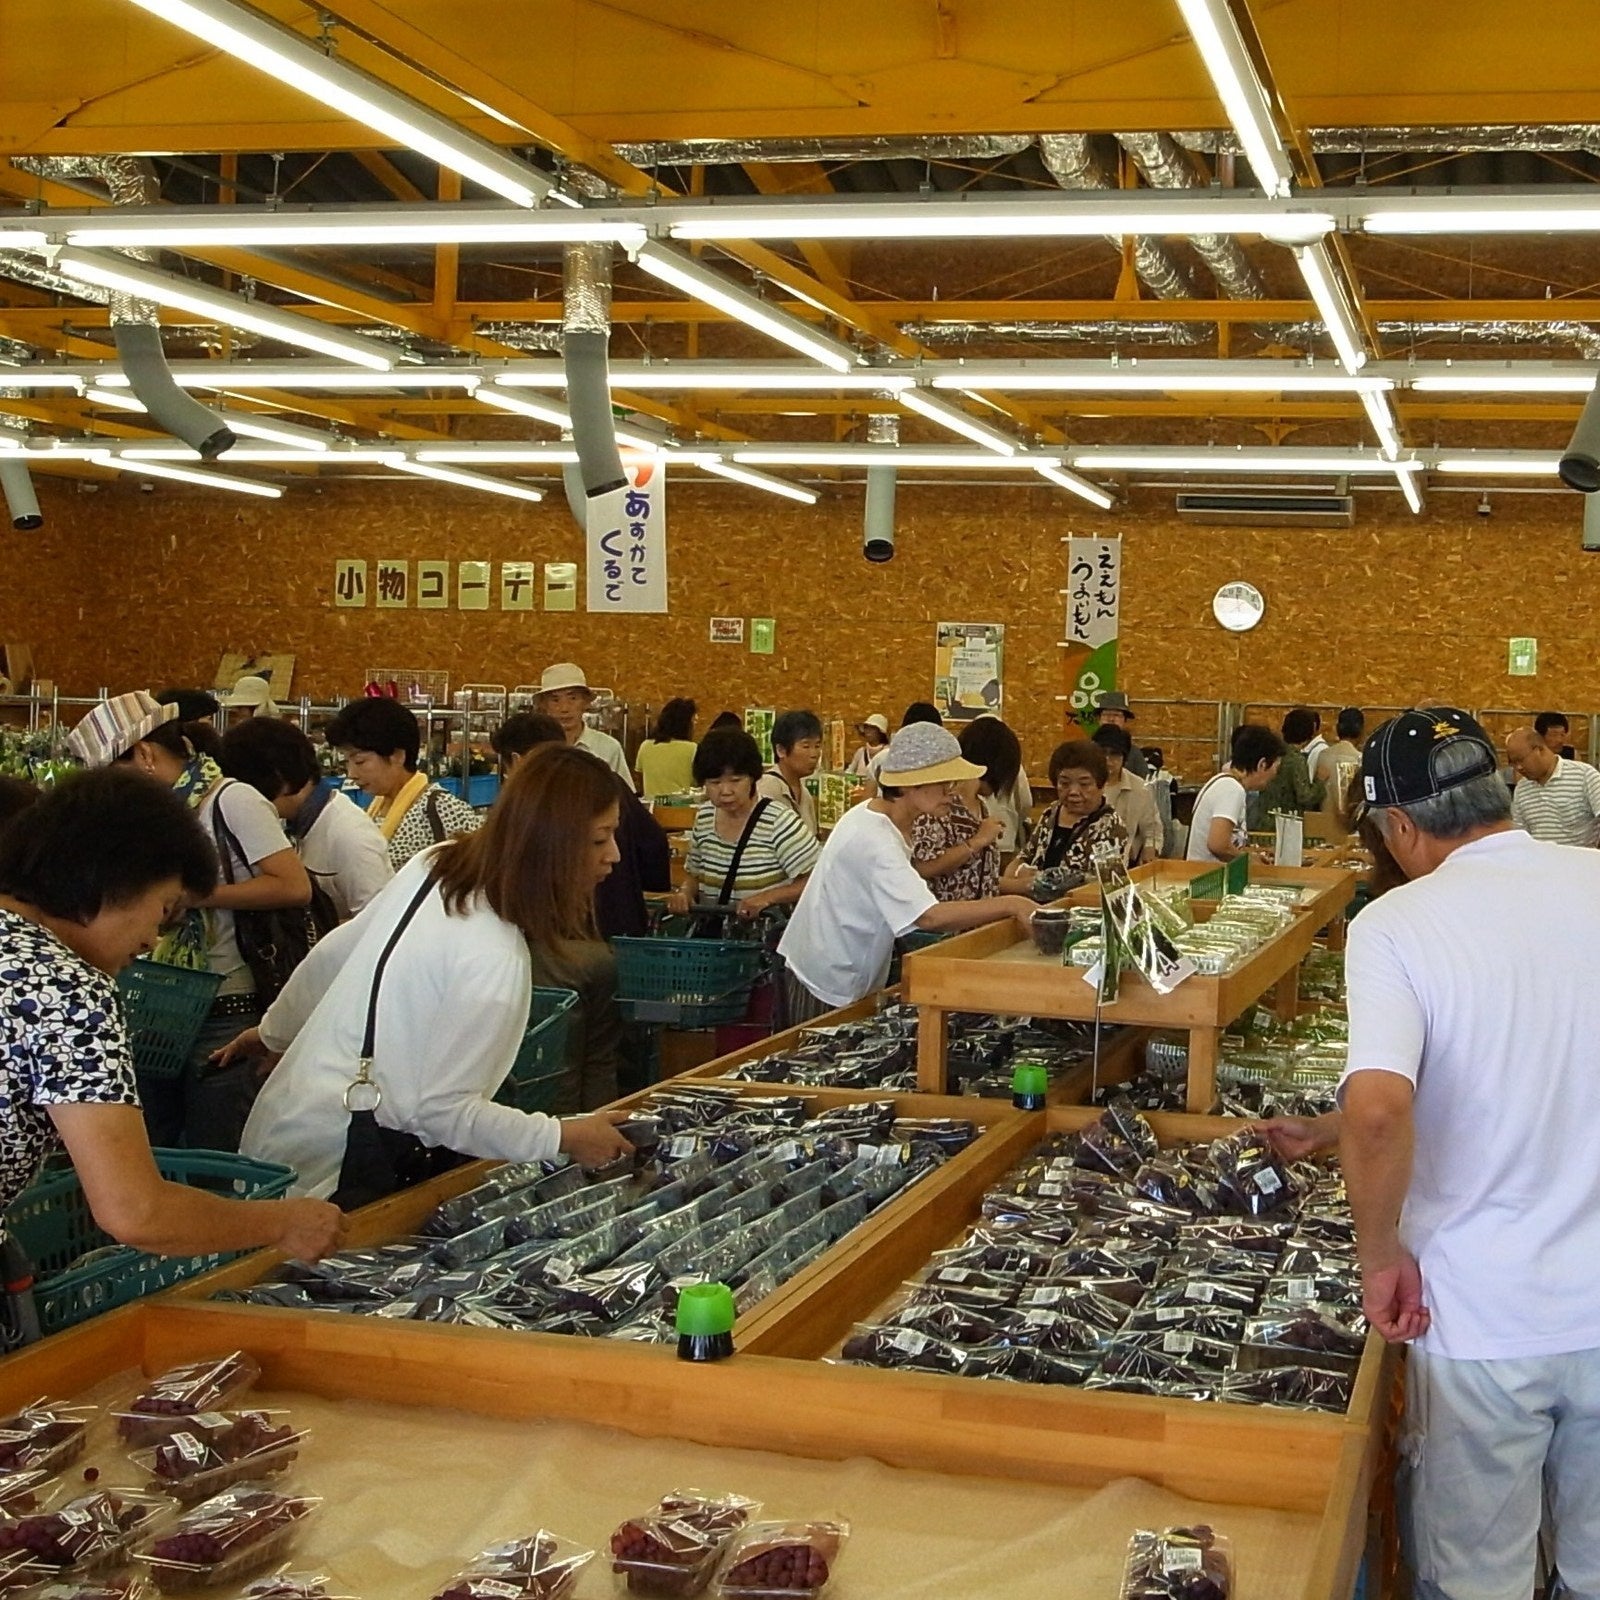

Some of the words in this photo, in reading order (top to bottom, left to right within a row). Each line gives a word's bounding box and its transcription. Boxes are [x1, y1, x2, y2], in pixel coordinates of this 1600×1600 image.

[600, 529, 625, 602] くるで
[625, 489, 650, 585] あすかて
[337, 566, 574, 602] 小物コーナー
[1072, 556, 1094, 639] うまいもん
[1094, 545, 1116, 618] ええもん
